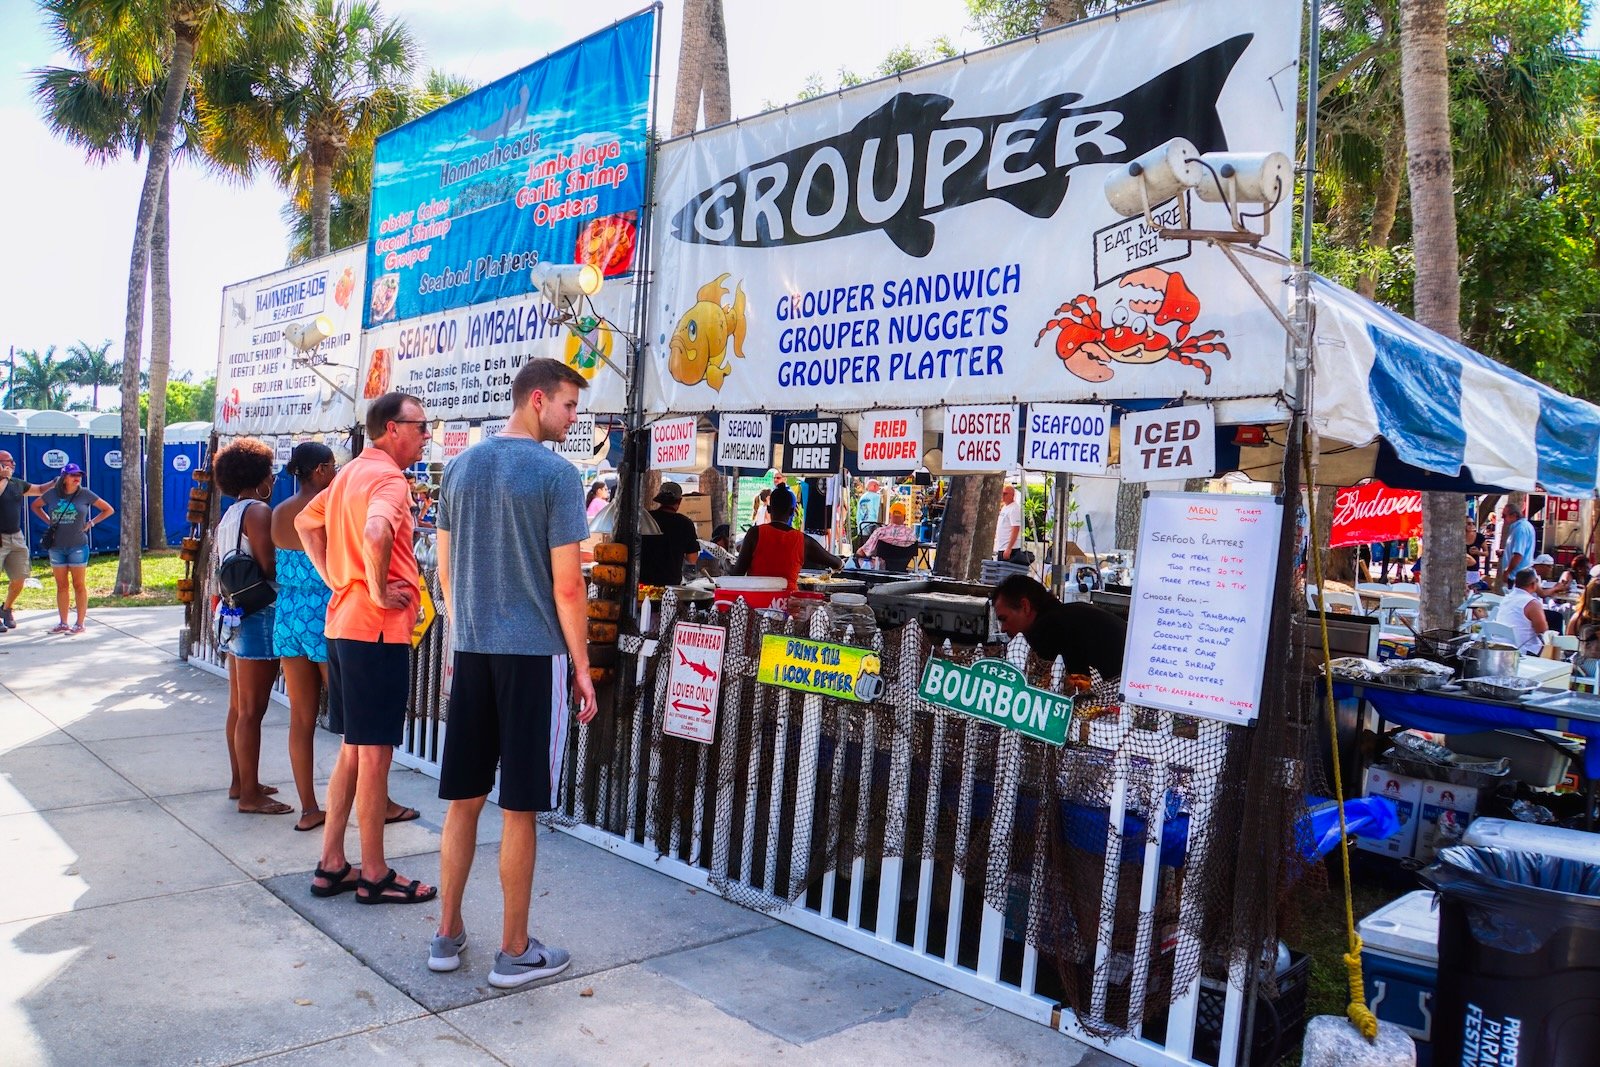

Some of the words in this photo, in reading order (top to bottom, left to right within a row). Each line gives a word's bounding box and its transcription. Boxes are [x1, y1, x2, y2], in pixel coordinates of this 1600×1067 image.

[439, 128, 541, 189] Hammerheads
[525, 140, 621, 184] Jambalaya
[515, 177, 561, 209] Garlic
[565, 163, 628, 195] Shrimp
[693, 110, 1128, 242] GROUPER
[380, 210, 415, 233] obster
[533, 194, 598, 228] Oysters
[411, 218, 451, 243] Shrimp
[1103, 226, 1132, 253] EAT
[1138, 205, 1180, 239] MORE
[385, 245, 432, 270] Grouper
[1126, 235, 1159, 262] FISH
[419, 260, 472, 295] Seafood
[474, 250, 538, 281] Platters
[256, 276, 327, 312] HAMMERHEADS
[776, 283, 875, 321] GROUPER
[882, 263, 1021, 309] SANDWICH
[272, 302, 304, 321] SEAFOOD
[252, 330, 281, 346] SEAFOOD
[397, 319, 457, 361] SEAFOOD
[464, 302, 561, 350] JAMBALAYA
[778, 318, 880, 354] GROUPER
[888, 304, 1009, 345] NUGGETS
[255, 347, 282, 361] SHRIMP
[320, 333, 351, 351] SHRIMP
[409, 369, 423, 381] The
[425, 364, 458, 379] Classic
[461, 361, 480, 375] Rice
[484, 357, 506, 371] Dish
[777, 354, 881, 387] GROUPER
[888, 344, 1004, 381] PLATTER
[427, 381, 458, 393] Clams,
[461, 376, 482, 390] Fish,
[486, 373, 514, 387] Crab,
[245, 405, 273, 418] SEAFOOD
[278, 402, 312, 416] PLATTERS
[421, 396, 459, 409] Sausage
[461, 392, 480, 405] and
[482, 389, 512, 403] Diced
[566, 421, 592, 435] OUPER
[654, 422, 694, 442] COCONUT
[727, 420, 763, 438] SEAFOOD
[788, 421, 837, 445] ORDER
[873, 419, 908, 438] FRIED
[951, 412, 1011, 435] LOBSTER
[1031, 414, 1104, 437] SEAFOOD
[1133, 419, 1201, 446] ICED
[443, 432, 468, 447] GROUPER
[557, 438, 591, 453] NUGGETS
[863, 441, 917, 460] GROUPER
[657, 443, 690, 463] SHRIMP
[721, 443, 766, 461] JAMBALAYA
[791, 447, 831, 469] HERE
[957, 440, 1001, 463] CAKES
[1031, 440, 1100, 463] PLATTER
[1140, 445, 1193, 470] TEA
[1188, 506, 1219, 516] MENU
[1332, 487, 1422, 528] Budweis
[1151, 531, 1196, 545] SEAFOOD
[1201, 533, 1244, 549] PLATTERS
[1171, 552, 1186, 560] ONE
[1159, 576, 1181, 584] THREE
[1187, 579, 1211, 587] ITEMS
[1231, 582, 1247, 590] TIX
[677, 630, 721, 651] HAMMERHEAD
[1153, 630, 1192, 640] COCONUT
[1197, 636, 1230, 646] SHRIMP
[786, 640, 819, 663] DRINK
[821, 646, 841, 666] TILL
[1151, 643, 1188, 653] LOBSTER
[1195, 649, 1217, 659] CAKE
[980, 664, 1017, 683] 1823
[1150, 656, 1178, 666] GARLIC
[1185, 660, 1216, 671] SHRIMP
[774, 664, 779, 682] I
[782, 665, 811, 687] LOOK
[813, 669, 853, 693] BETTER
[1148, 667, 1184, 680] BREADED
[1188, 674, 1224, 686] OYSTERS
[672, 681, 695, 699] LOVER
[696, 686, 714, 702] ONLY
[924, 663, 1053, 732] BOURBON
[1053, 701, 1070, 719] ST
[1128, 681, 1152, 690] SWEET
[1155, 685, 1168, 693] TEA
[1211, 695, 1225, 703] TEA
[1229, 700, 1253, 709] WATER
[1462, 1003, 1483, 1067] FESTIV
[1479, 1018, 1501, 1067] PARA
[1501, 1016, 1521, 1067] PROPE
